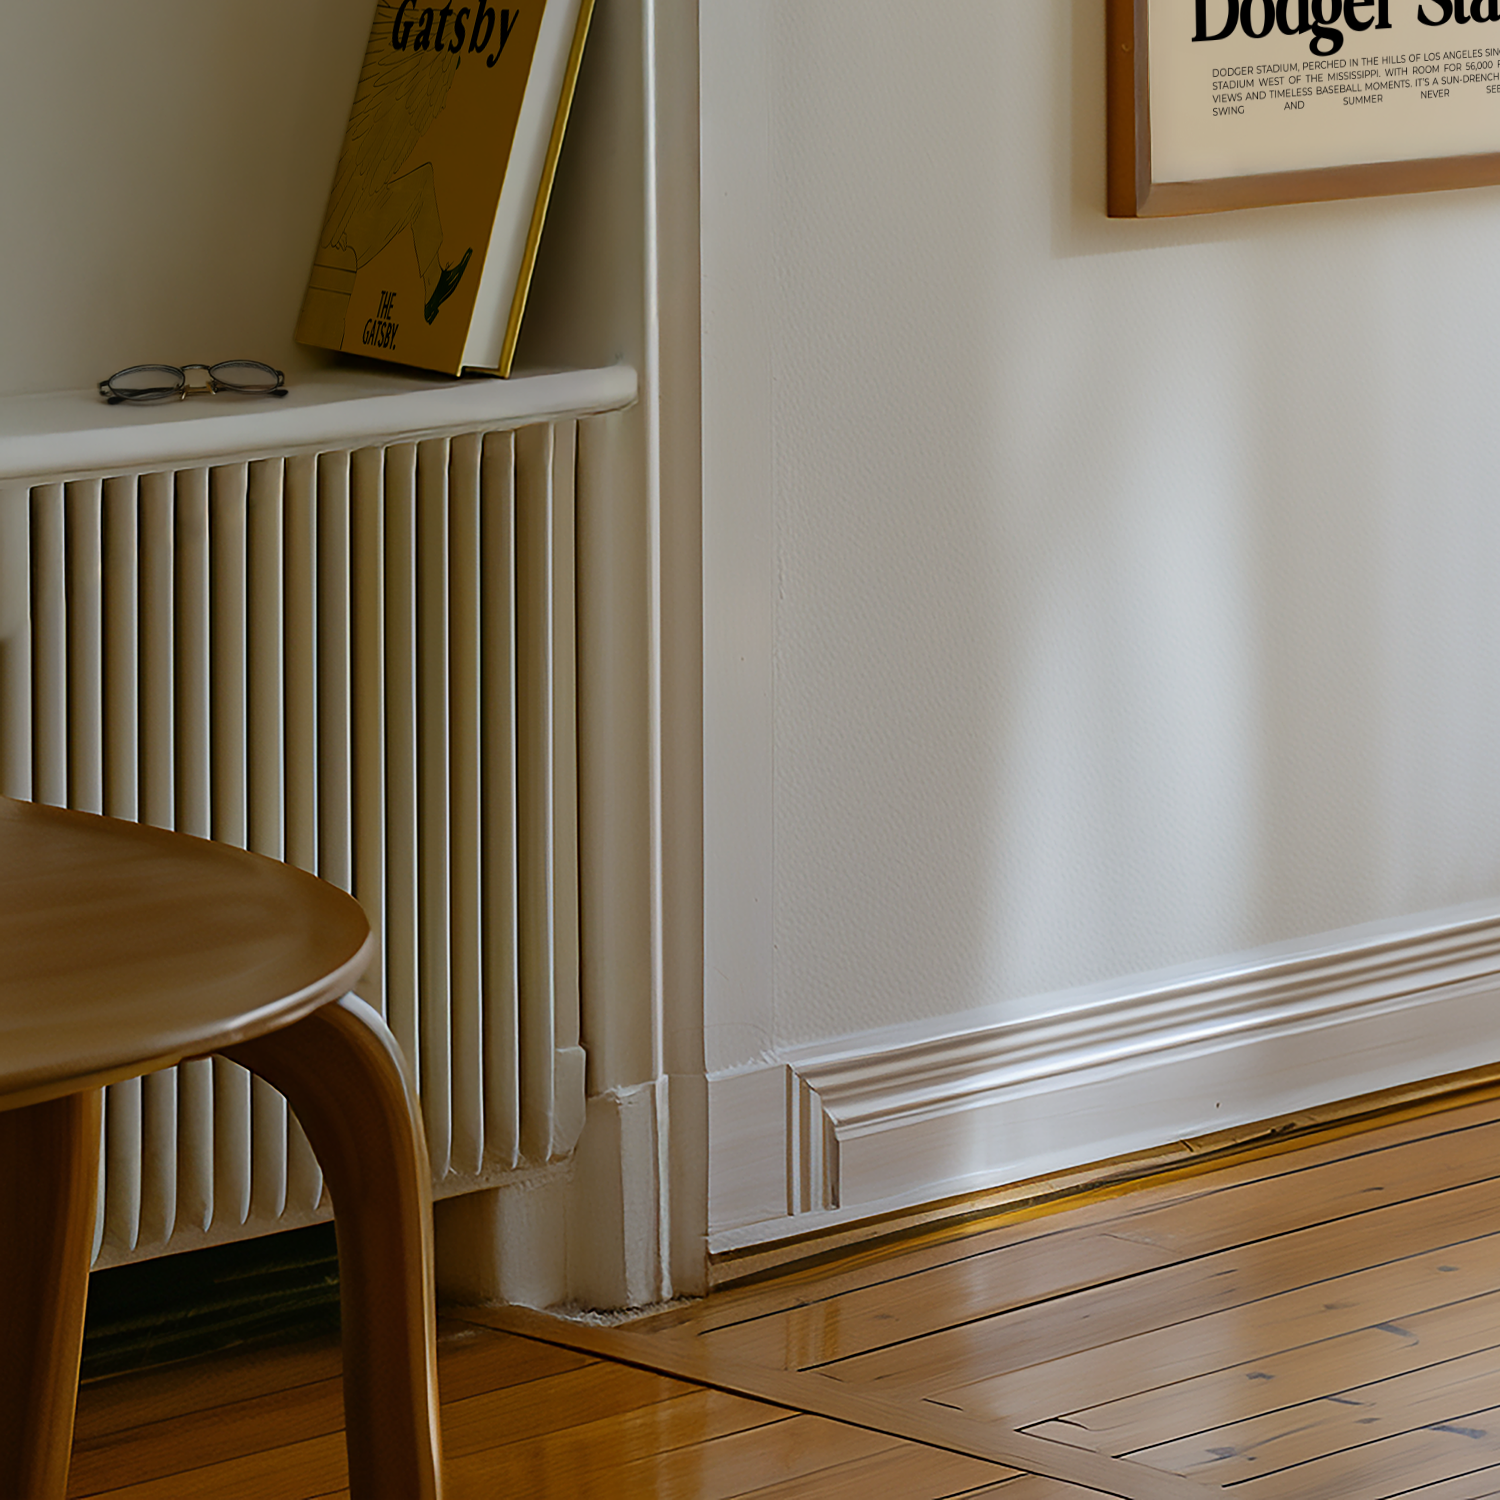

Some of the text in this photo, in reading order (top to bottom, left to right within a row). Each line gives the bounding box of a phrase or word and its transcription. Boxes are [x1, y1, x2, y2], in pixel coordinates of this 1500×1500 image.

[1212, 66, 1253, 77] DODGER
[1256, 63, 1300, 74] STADIUM,
[1303, 59, 1346, 70] PERCHED
[1350, 58, 1358, 67] IN
[1361, 57, 1378, 66] THE
[1382, 55, 1406, 64] HILLS
[1409, 54, 1421, 62] OF
[1424, 52, 1440, 61] LOS
[1443, 49, 1483, 60] ANGELES
[1213, 79, 1254, 90] STADIUM
[1259, 76, 1284, 86] WEST
[1289, 75, 1301, 84] OF
[1305, 73, 1323, 83] THE
[1385, 67, 1407, 76] WITH
[1413, 65, 1439, 74] ROOM
[1444, 63, 1462, 72] FOR
[1212, 92, 1242, 103] VIEWS
[1245, 91, 1266, 100] AND
[1269, 87, 1312, 98] TIMELESS
[1316, 84, 1362, 95] BASEBALL
[1432, 77, 1438, 85] A
[1213, 105, 1244, 116] SWING
[1284, 101, 1305, 110] AND
[1343, 94, 1383, 105] SUMMER
[1421, 89, 1449, 99] NEVER
[377, 290, 396, 320] THE
[362, 319, 398, 350] GATSBY.
